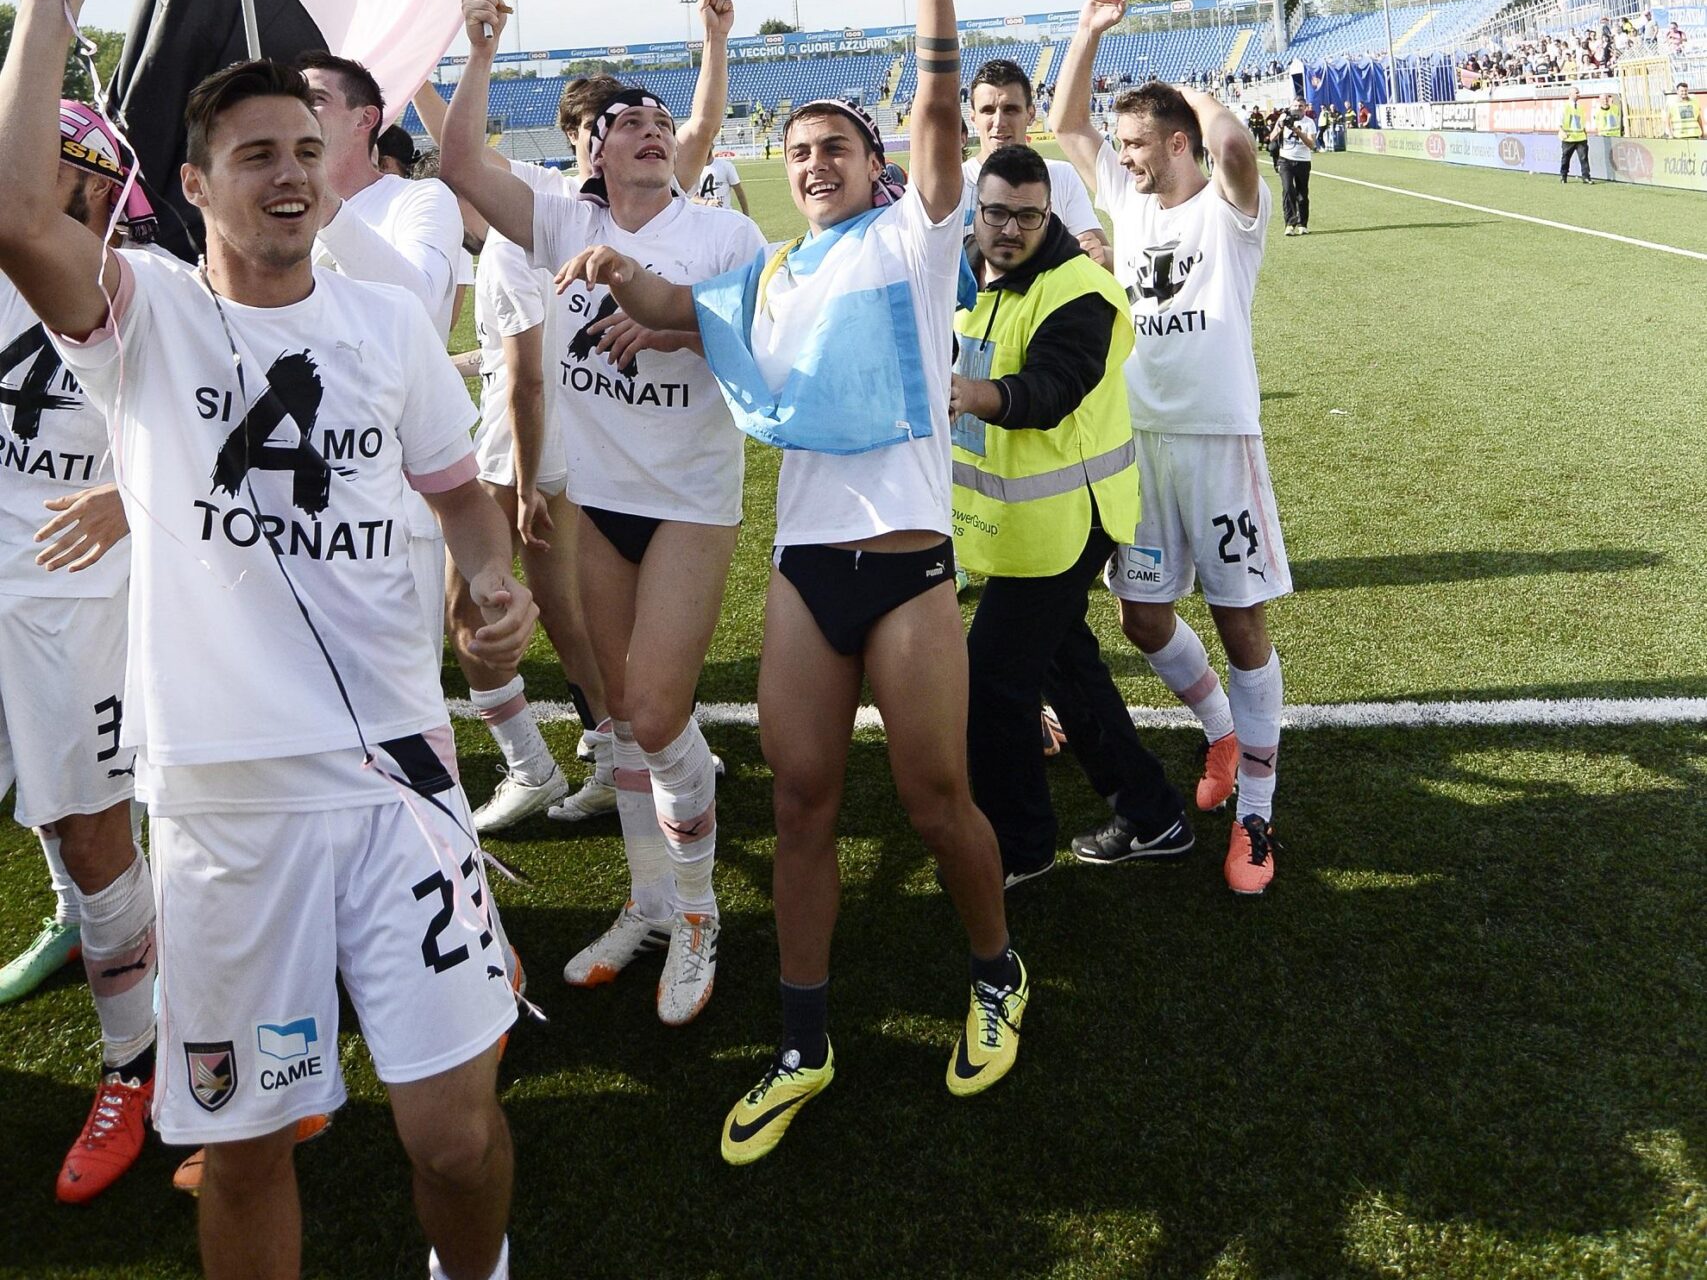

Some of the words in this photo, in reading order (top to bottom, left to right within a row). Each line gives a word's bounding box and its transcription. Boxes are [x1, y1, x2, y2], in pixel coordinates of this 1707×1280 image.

[1131, 4, 1169, 15] Gorgonzola
[739, 45, 785, 58] VECCHIO
[800, 40, 836, 53] CUORE
[1663, 151, 1696, 176] radici
[568, 294, 592, 317] SI
[61, 368, 84, 395] M
[560, 360, 689, 408] TORNATI
[195, 386, 233, 422] SI
[323, 427, 383, 460] MO
[0, 433, 95, 481] NATI
[193, 500, 394, 561] TORNATI
[1127, 569, 1161, 583] CAME
[260, 1055, 323, 1091] CAME
